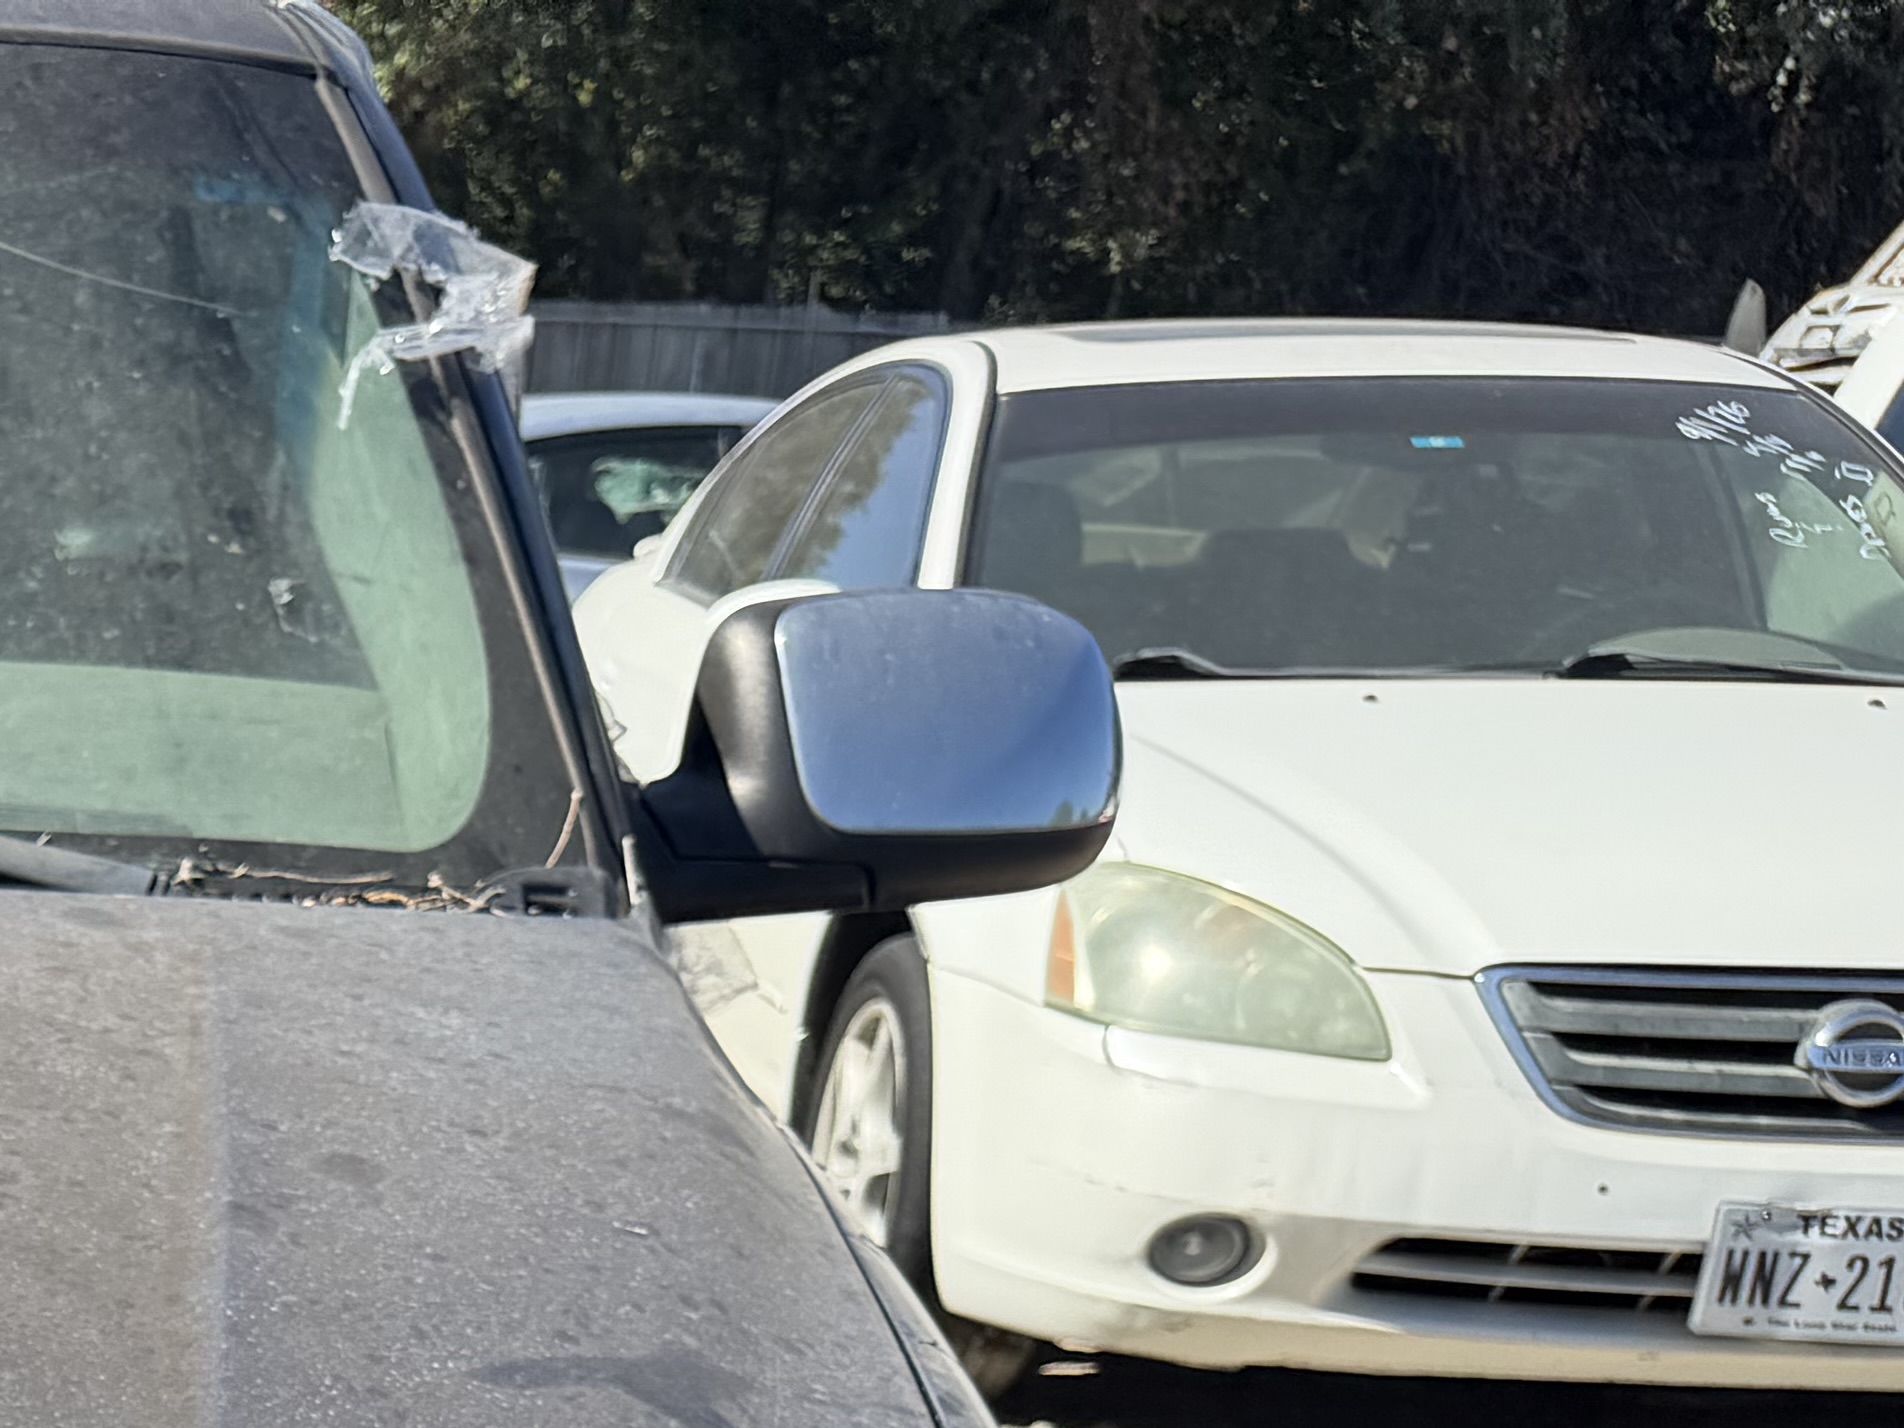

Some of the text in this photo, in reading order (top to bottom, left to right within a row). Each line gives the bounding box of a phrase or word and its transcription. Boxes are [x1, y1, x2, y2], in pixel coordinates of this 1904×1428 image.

[1823, 1048, 1904, 1068] NISSA
[1796, 1213, 1904, 1243] TEXAS
[1836, 1252, 1904, 1315] 21
